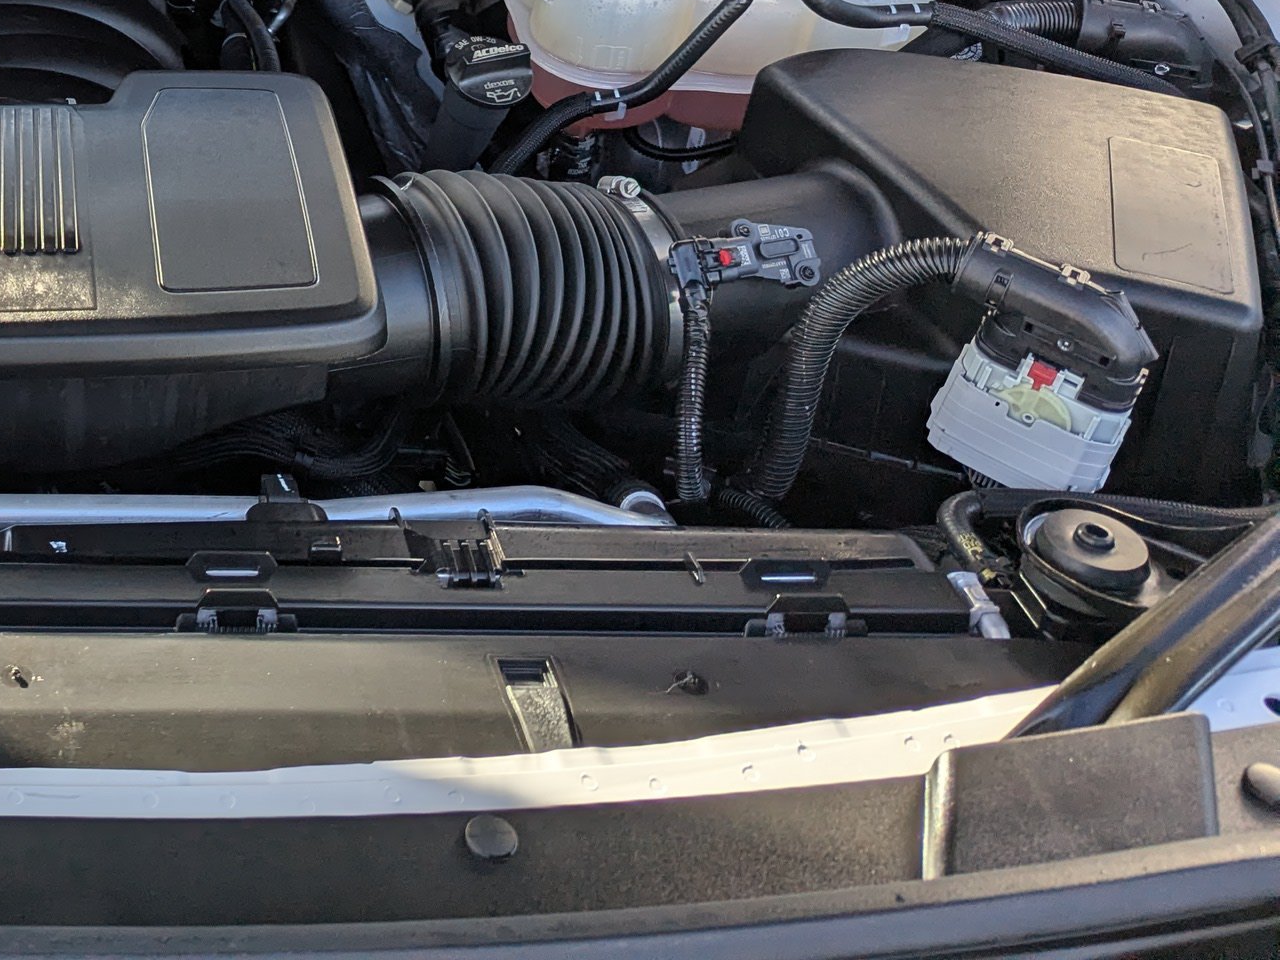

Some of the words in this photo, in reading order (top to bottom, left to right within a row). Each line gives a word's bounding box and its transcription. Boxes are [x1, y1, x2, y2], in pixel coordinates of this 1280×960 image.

[455, 39, 470, 50] SAE
[470, 35, 497, 44] 0W-20
[473, 44, 525, 59] ACDelco
[483, 79, 515, 90] dexos
